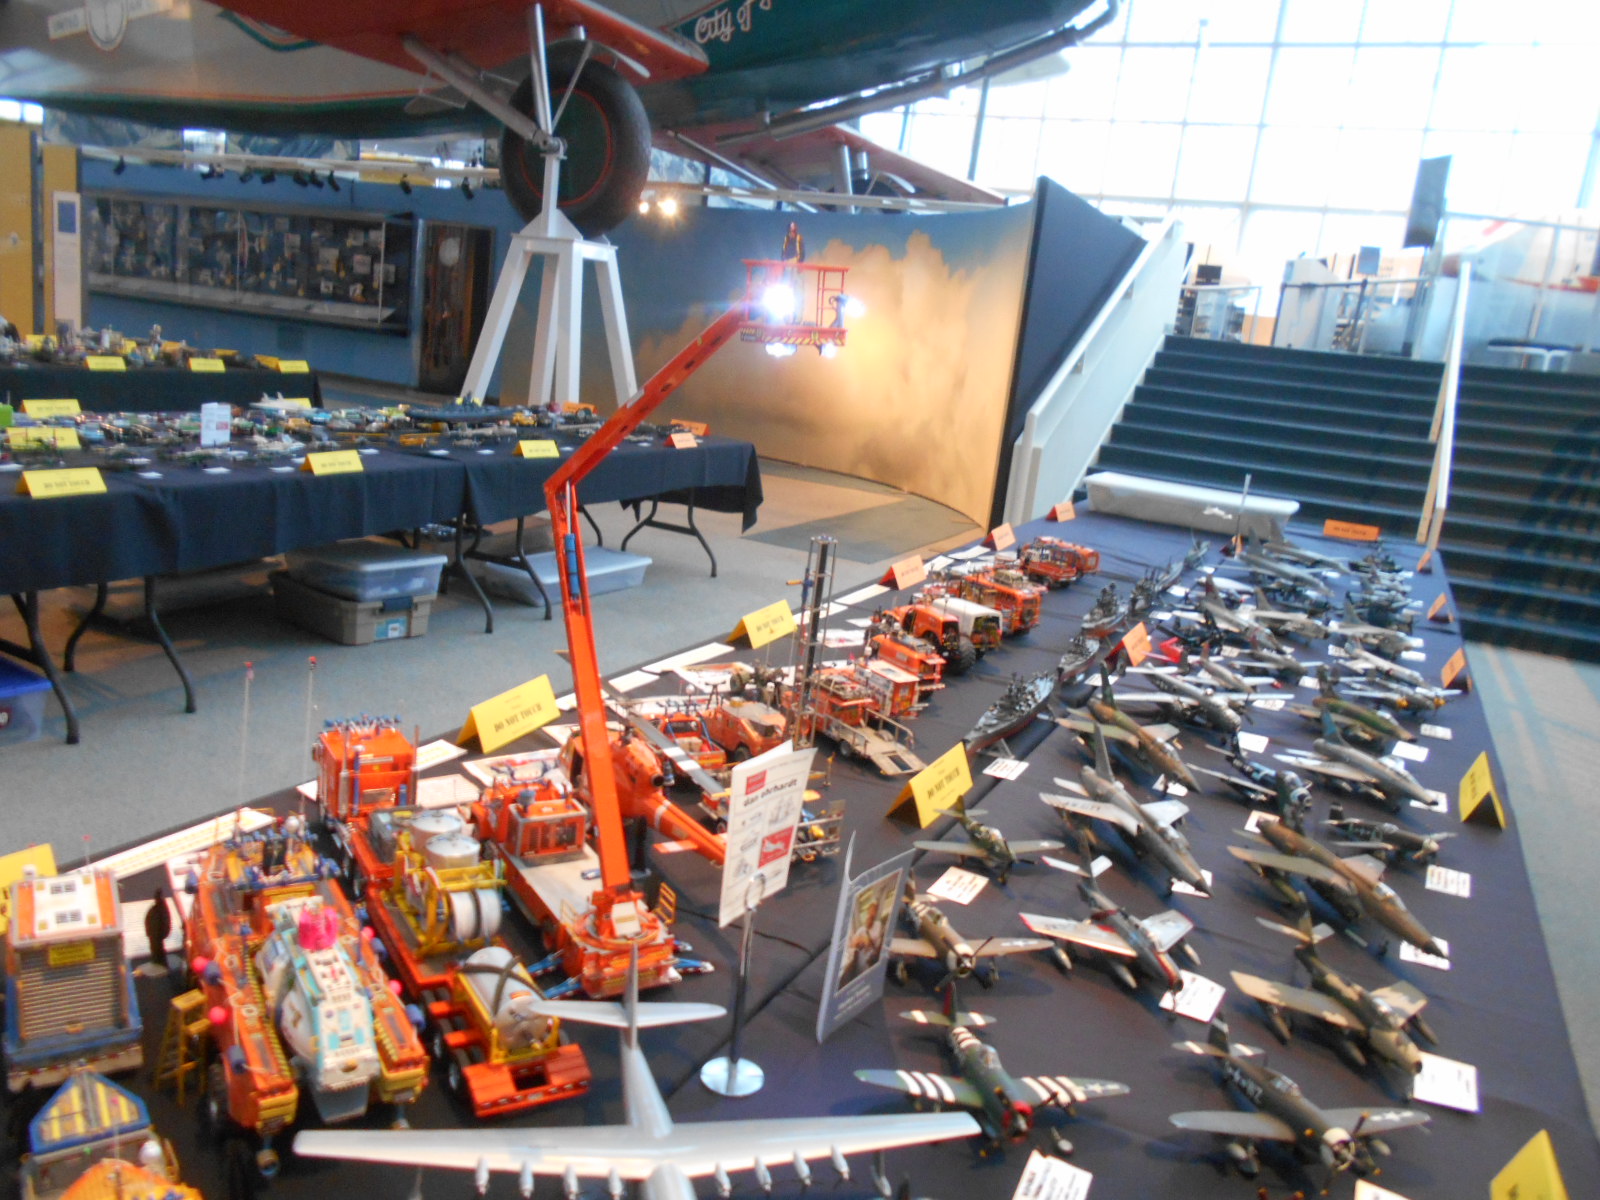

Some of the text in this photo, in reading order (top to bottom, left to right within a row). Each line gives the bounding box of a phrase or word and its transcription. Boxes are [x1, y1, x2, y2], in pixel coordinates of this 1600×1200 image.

[695, 7, 735, 43] City
[505, 715, 520, 729] NOT
[520, 703, 543, 720] TOUCH
